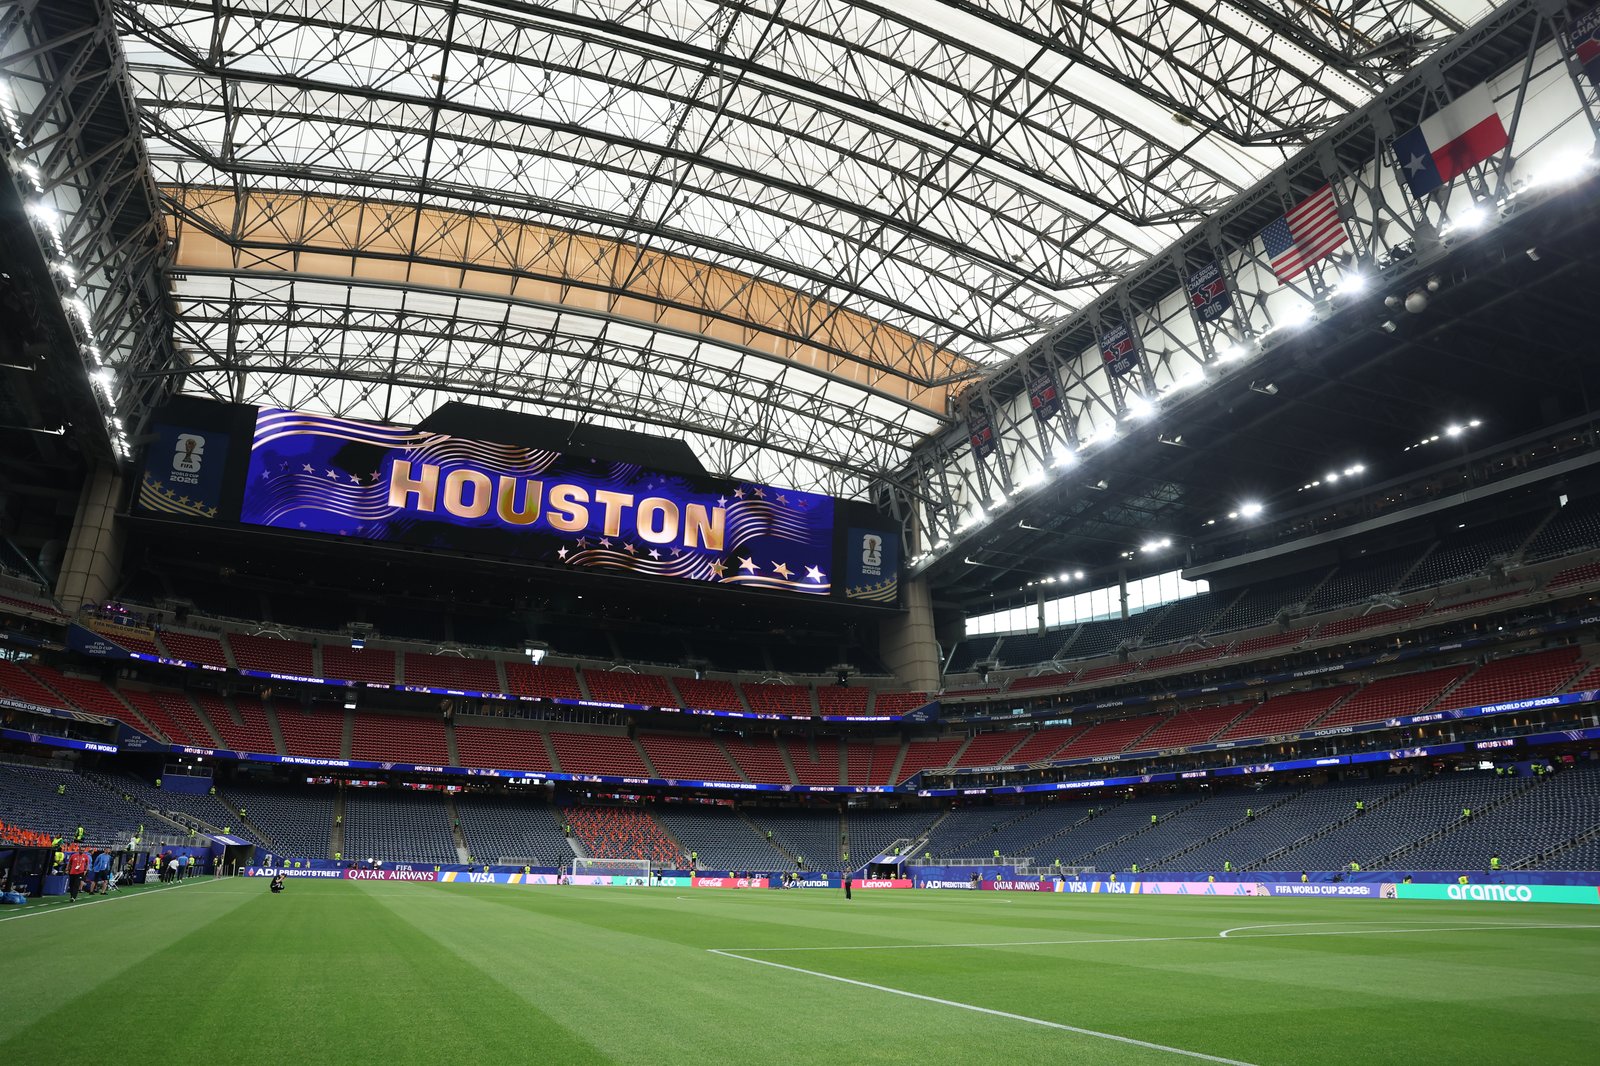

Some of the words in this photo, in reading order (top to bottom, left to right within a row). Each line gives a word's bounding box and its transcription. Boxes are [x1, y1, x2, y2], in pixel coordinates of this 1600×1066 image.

[1188, 267, 1218, 290] CHAMPIONS
[1203, 301, 1222, 318] 2016
[1113, 358, 1130, 373] 2015
[169, 475, 199, 485] 2026
[387, 459, 728, 551] HOUSTON
[862, 568, 881, 576] 2026
[202, 664, 227, 672] HOUSTON
[11, 701, 27, 709] WORLD
[1096, 701, 1123, 709] HOUSTON
[1481, 705, 1496, 714] FIFA
[1496, 702, 1520, 712] WORLD
[1534, 697, 1560, 706] 2026
[1411, 713, 1442, 723] HOUSTON
[1314, 727, 1353, 737] HOUSTON
[85, 743, 97, 751] FIFA
[98, 745, 118, 753] WORLD
[1477, 739, 1514, 749] HOUSTON
[184, 747, 214, 756] HOUSTON
[294, 757, 316, 765] WORLD
[1092, 754, 1121, 762] HOUSTON
[254, 868, 278, 877] ADI
[348, 869, 385, 880] QATAR
[388, 870, 435, 881] AIRWAYS
[468, 872, 496, 883] VISA
[698, 877, 724, 887] Coca-Cola
[861, 880, 893, 888] Lenovo
[925, 880, 942, 889] ADI
[993, 881, 1013, 891] QATAR
[1014, 882, 1041, 891] AIRWAYS
[1068, 882, 1088, 893] VISA
[1105, 882, 1127, 894] VISA
[1275, 885, 1291, 894] FIFA
[1291, 886, 1320, 895] WORLD
[1321, 886, 1338, 895] CUP
[1338, 886, 1368, 896] 2026
[1446, 884, 1532, 902] aramco
